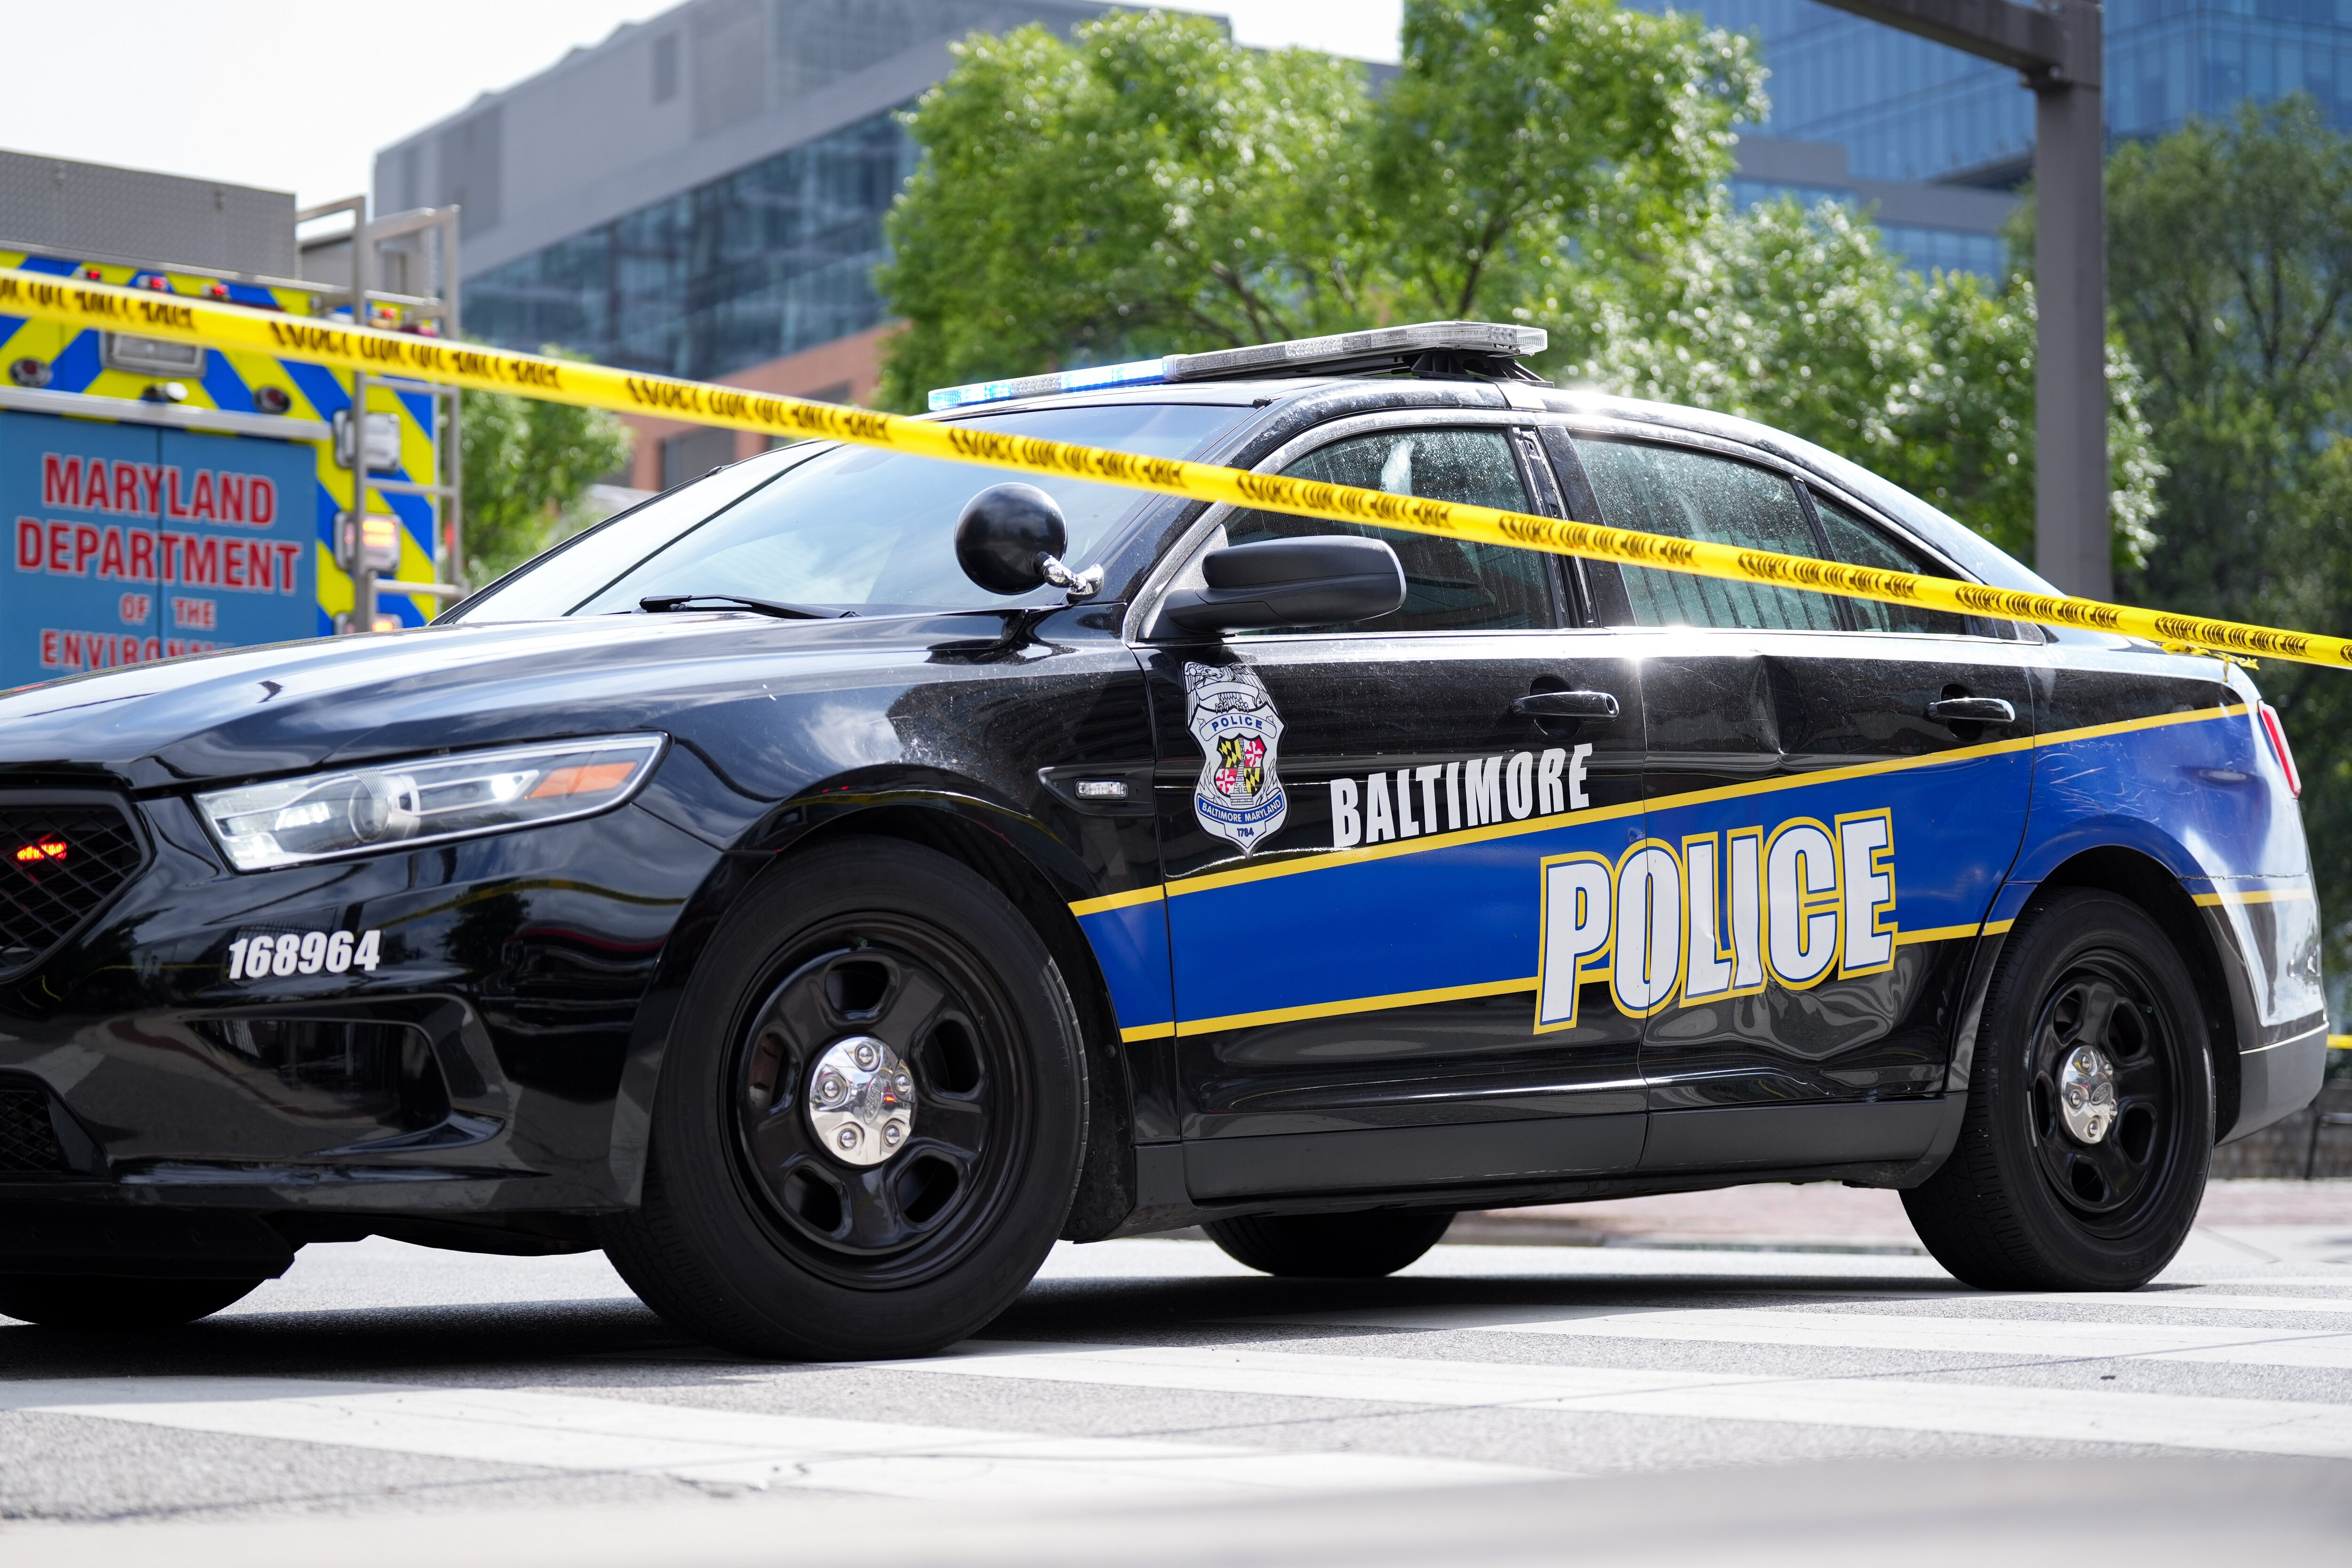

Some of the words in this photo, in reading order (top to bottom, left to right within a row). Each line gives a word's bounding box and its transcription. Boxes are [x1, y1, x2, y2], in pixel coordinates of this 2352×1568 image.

[43, 453, 277, 528] MARYLAND
[16, 517, 302, 595] DEPARTMENT
[119, 593, 151, 625] OF
[171, 596, 217, 631] THE
[1211, 716, 1263, 732] POLICE
[1202, 802, 1242, 822] BALTIMORE
[1245, 799, 1281, 822] MARYLAND
[1330, 743, 1592, 848] BALTIMORE
[1534, 807, 1898, 1035] POLICE
[229, 930, 381, 979] 168964
